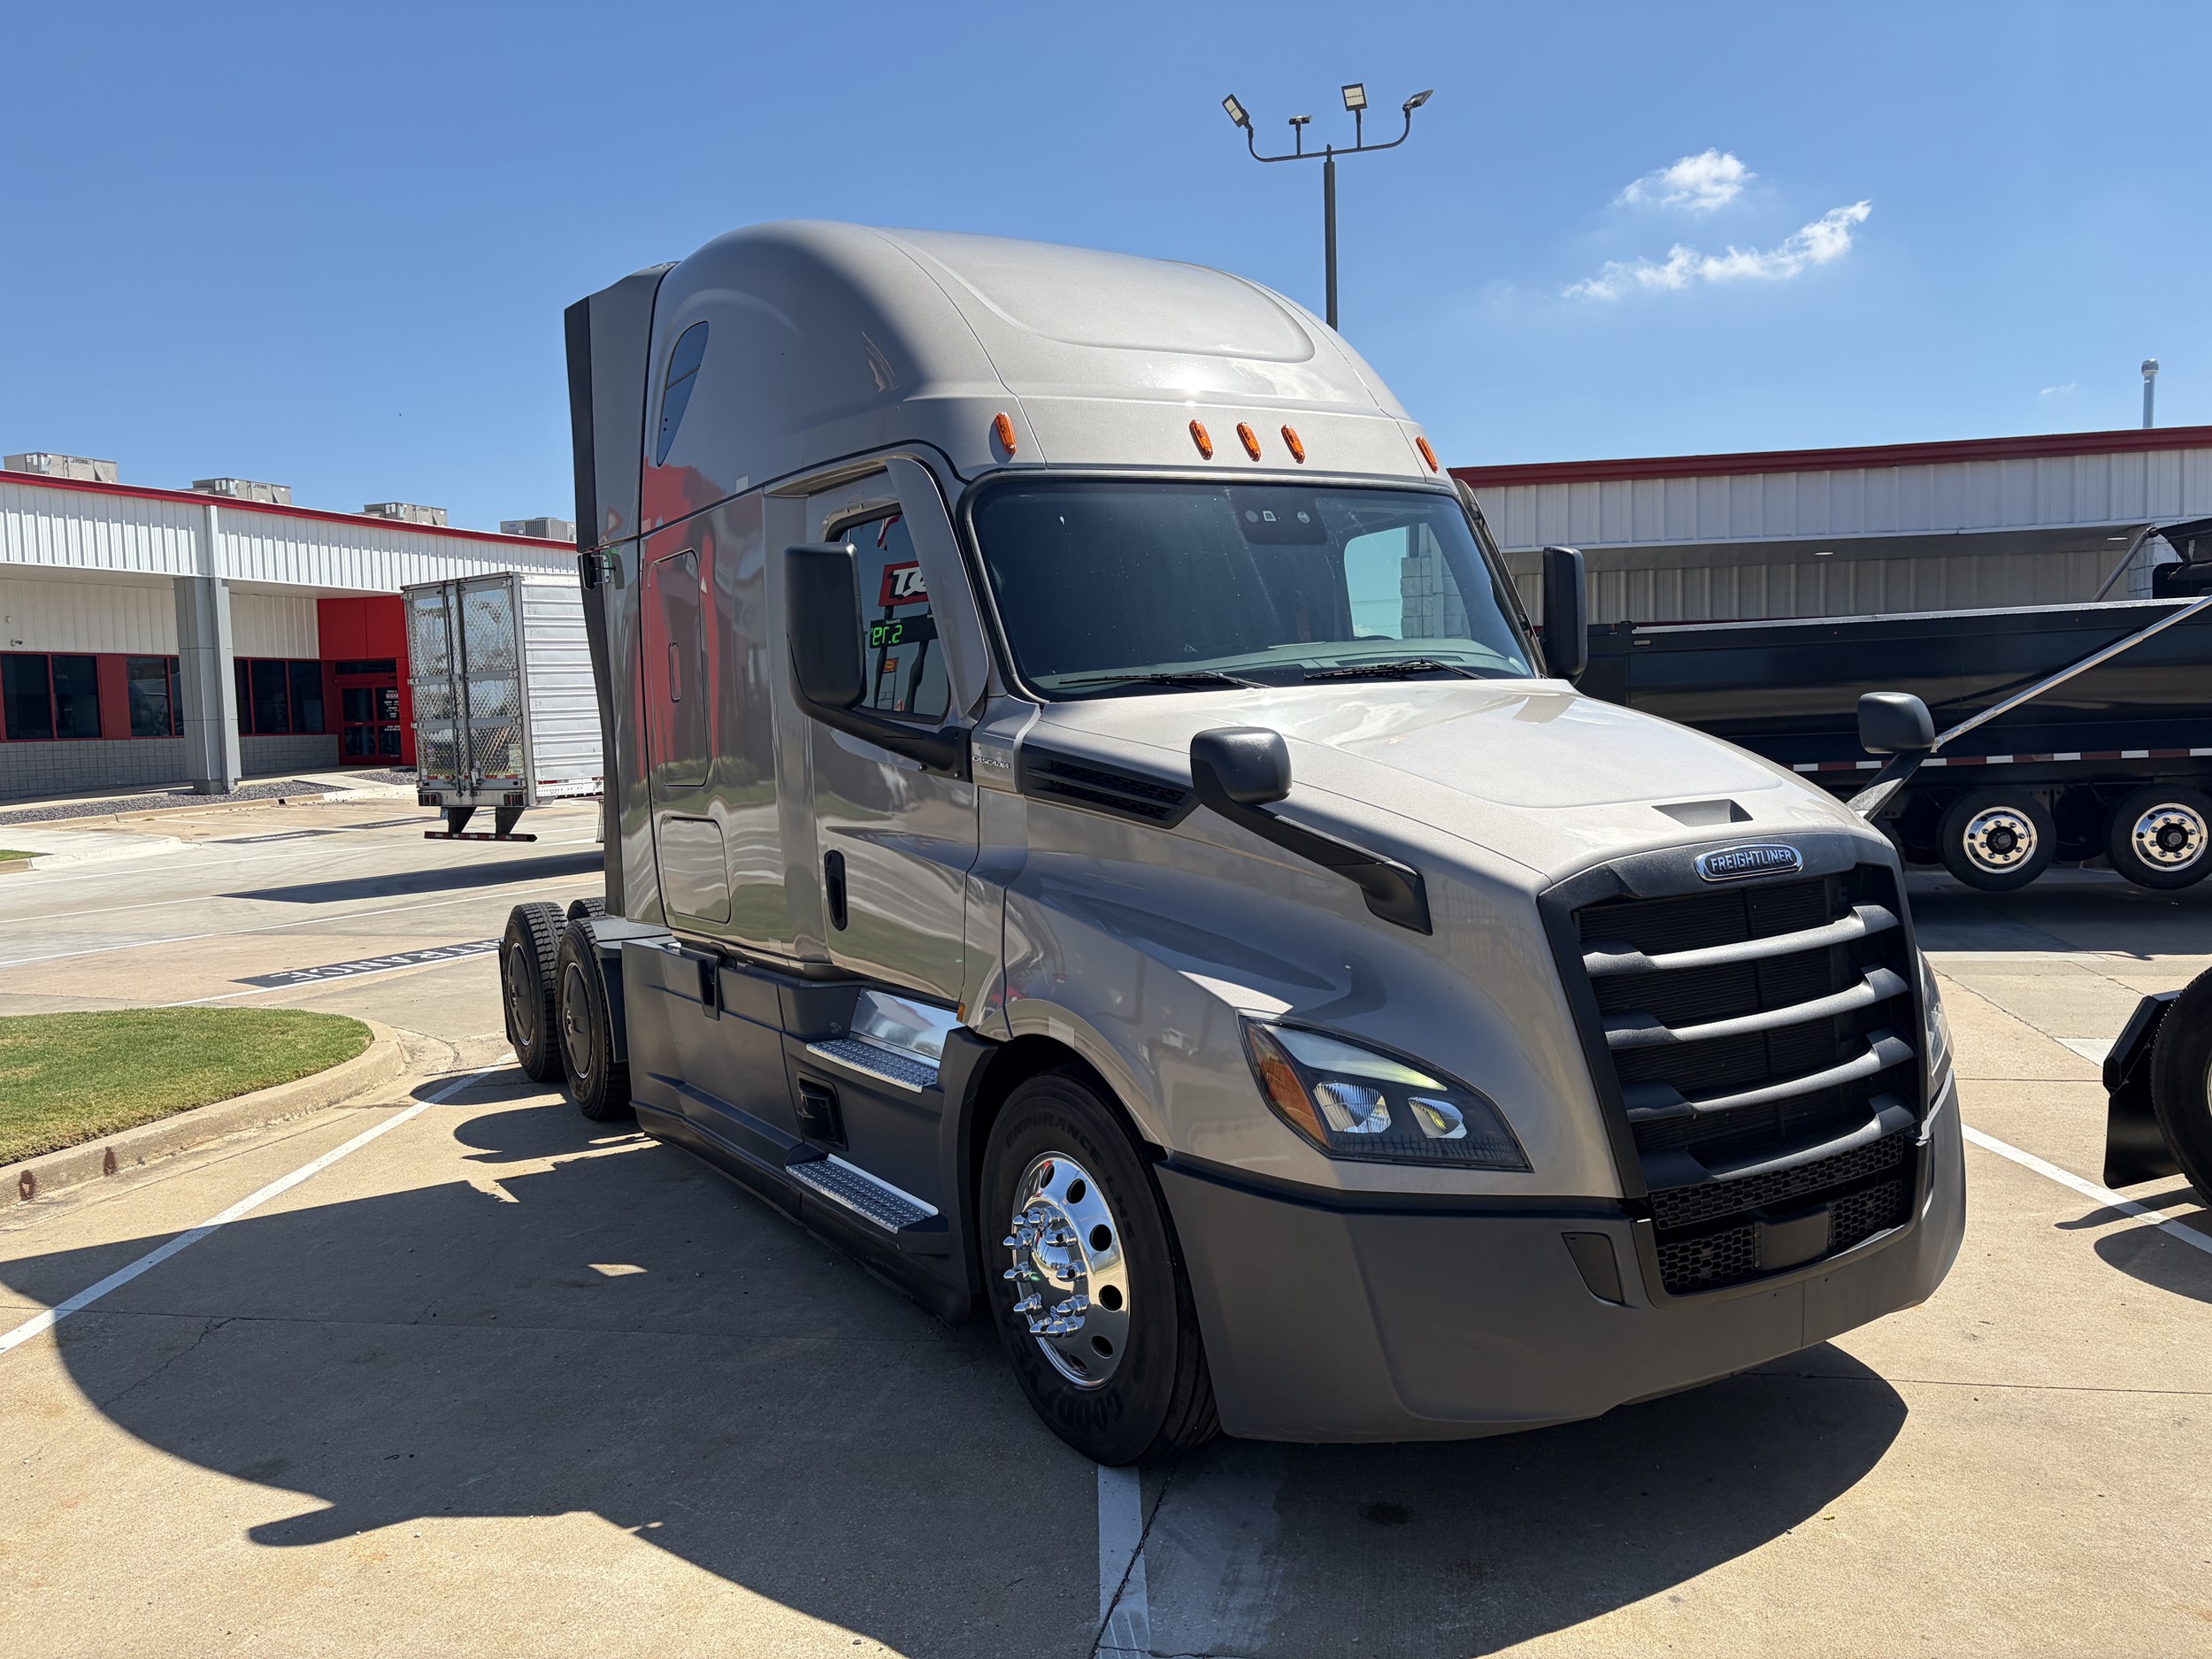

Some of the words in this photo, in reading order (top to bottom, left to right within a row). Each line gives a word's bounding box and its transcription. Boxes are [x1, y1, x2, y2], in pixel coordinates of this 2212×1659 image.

[972, 756, 1010, 769] CASCADIA
[1710, 849, 1793, 872] FREIGHTLINER
[270, 940, 500, 982] NTRANCE
[1005, 1113, 1103, 1166] ENDURANCE
